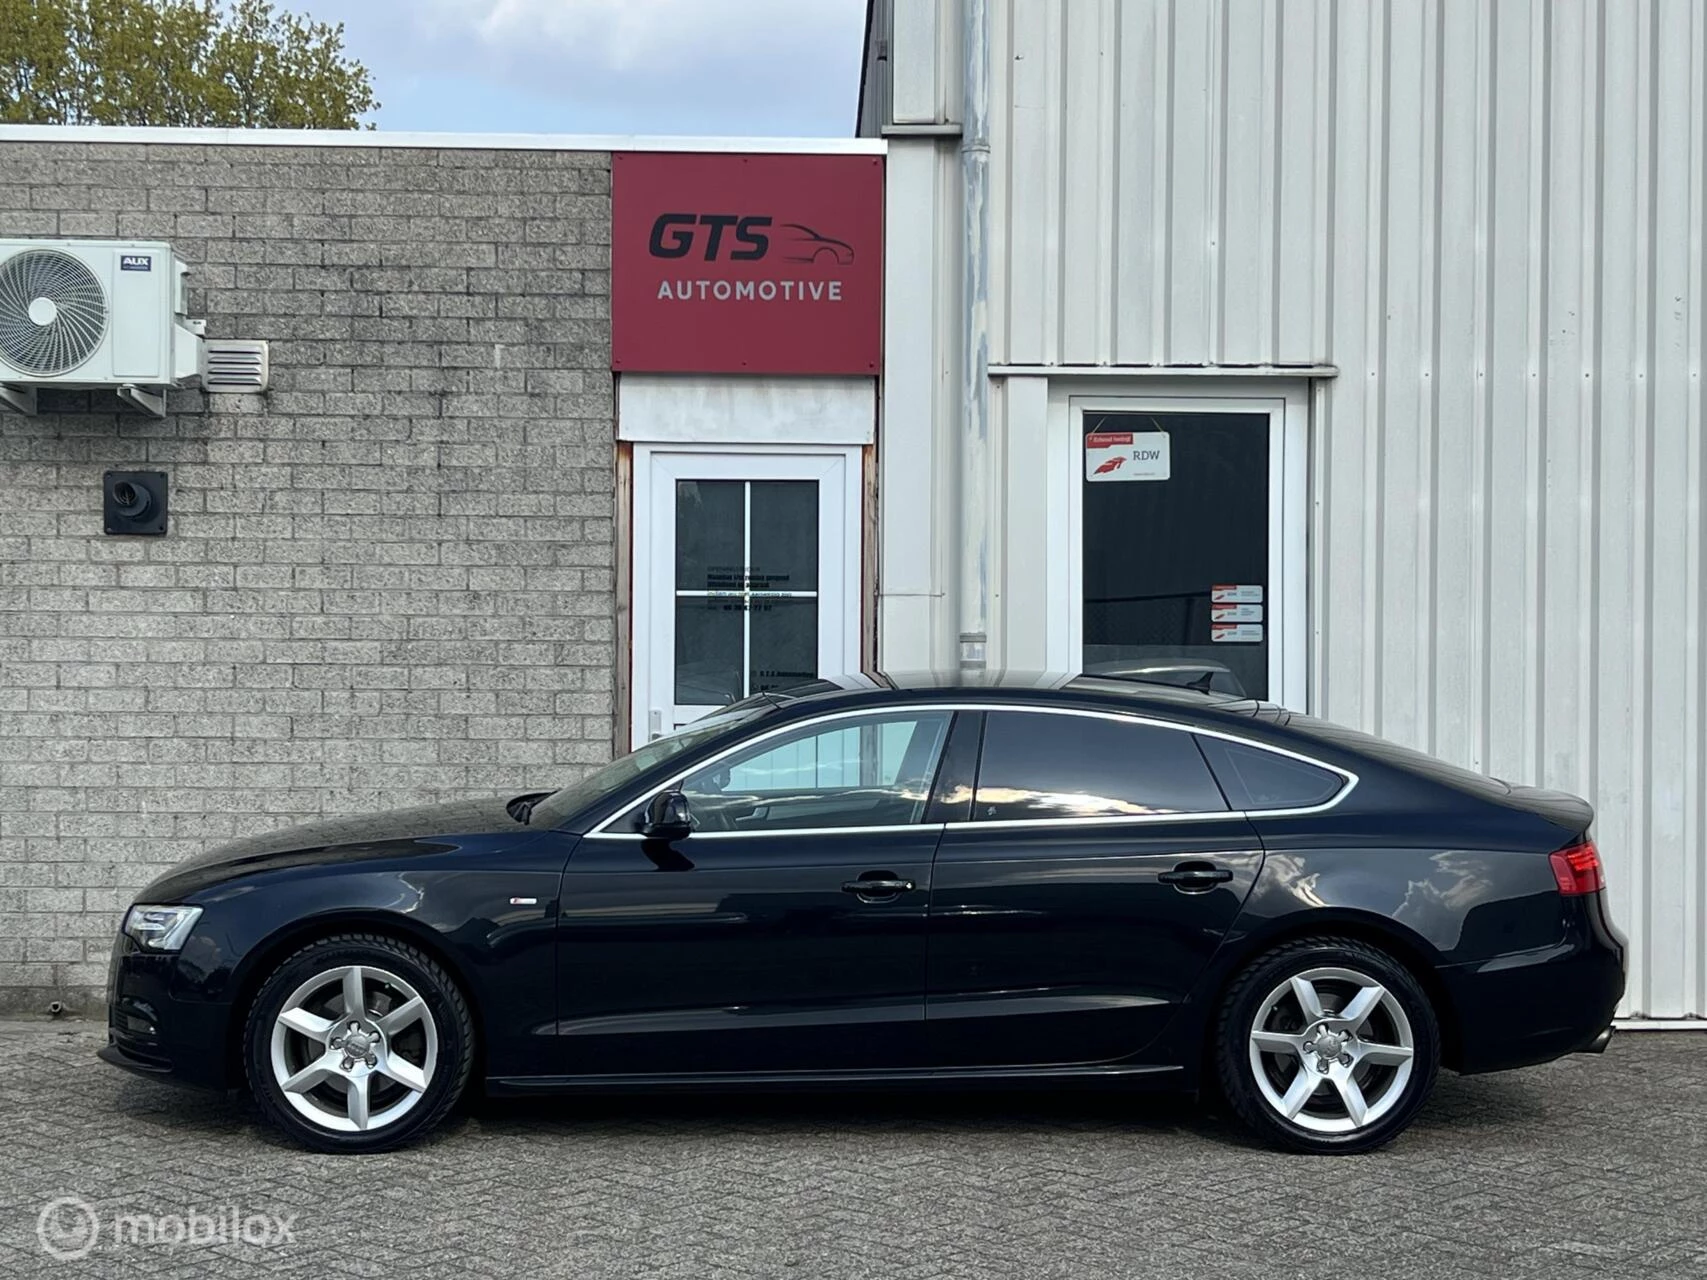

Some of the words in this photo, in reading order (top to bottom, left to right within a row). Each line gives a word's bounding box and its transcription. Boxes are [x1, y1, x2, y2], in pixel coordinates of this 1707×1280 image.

[649, 213, 773, 262] GTS
[123, 257, 149, 265] AUX
[657, 280, 842, 301] AUTOMOTIVE
[1133, 450, 1160, 461] RDW
